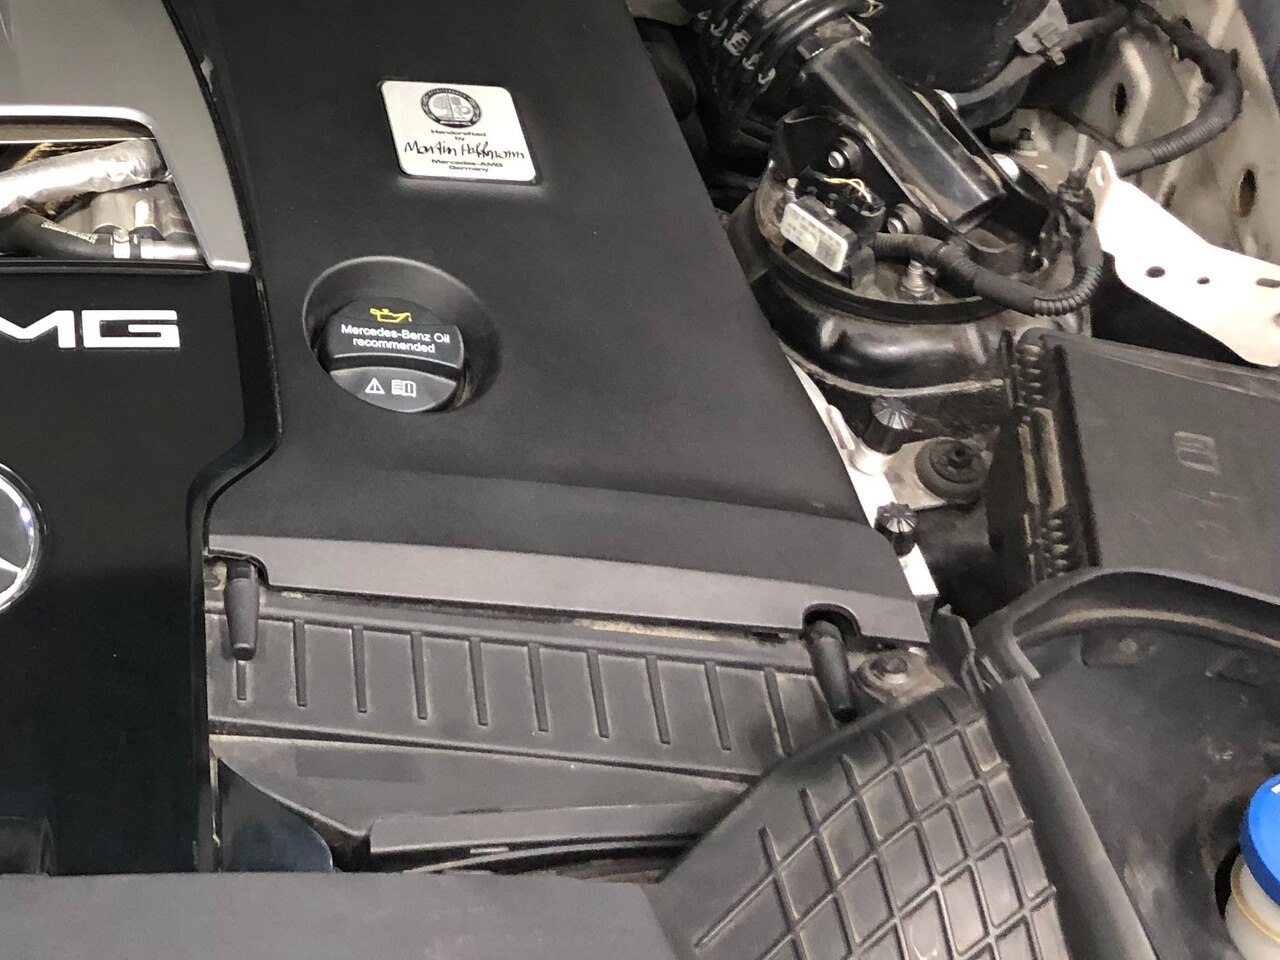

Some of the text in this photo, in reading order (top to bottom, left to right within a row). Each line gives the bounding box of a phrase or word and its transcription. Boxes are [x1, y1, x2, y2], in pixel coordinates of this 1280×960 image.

[430, 129, 487, 137] Handcrafted
[431, 159, 504, 168] Mercedes-AMG
[448, 165, 489, 173] Germany
[340, 324, 451, 344] Mercedes-Benz Oil
[352, 338, 435, 353] recommended
